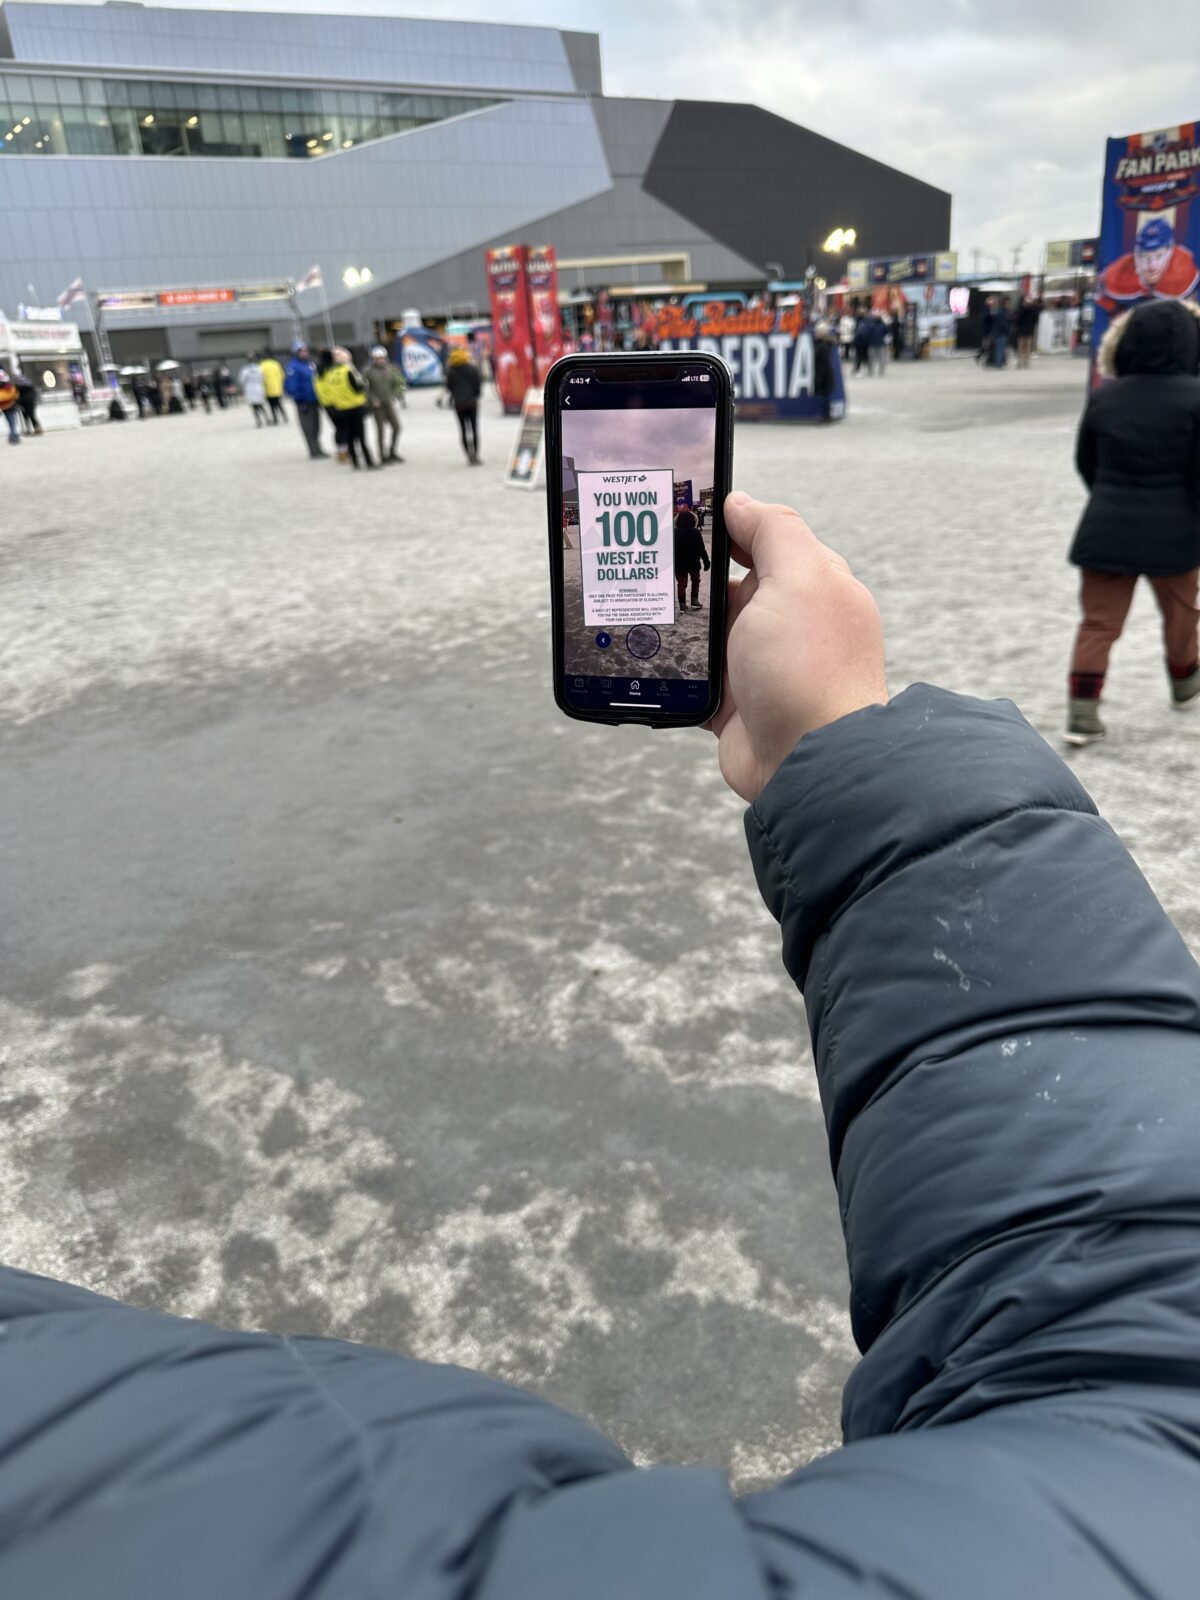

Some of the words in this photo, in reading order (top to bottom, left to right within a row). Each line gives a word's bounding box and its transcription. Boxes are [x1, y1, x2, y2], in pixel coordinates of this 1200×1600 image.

[1115, 156, 1153, 179] FAN
[659, 332, 815, 399] ERTA
[602, 475, 638, 484] WESTJET
[594, 491, 621, 506] YOU
[626, 491, 657, 506] WON
[596, 510, 658, 547] 100
[596, 551, 658, 566] WESTJET
[597, 568, 658, 581] DOLLARS!
